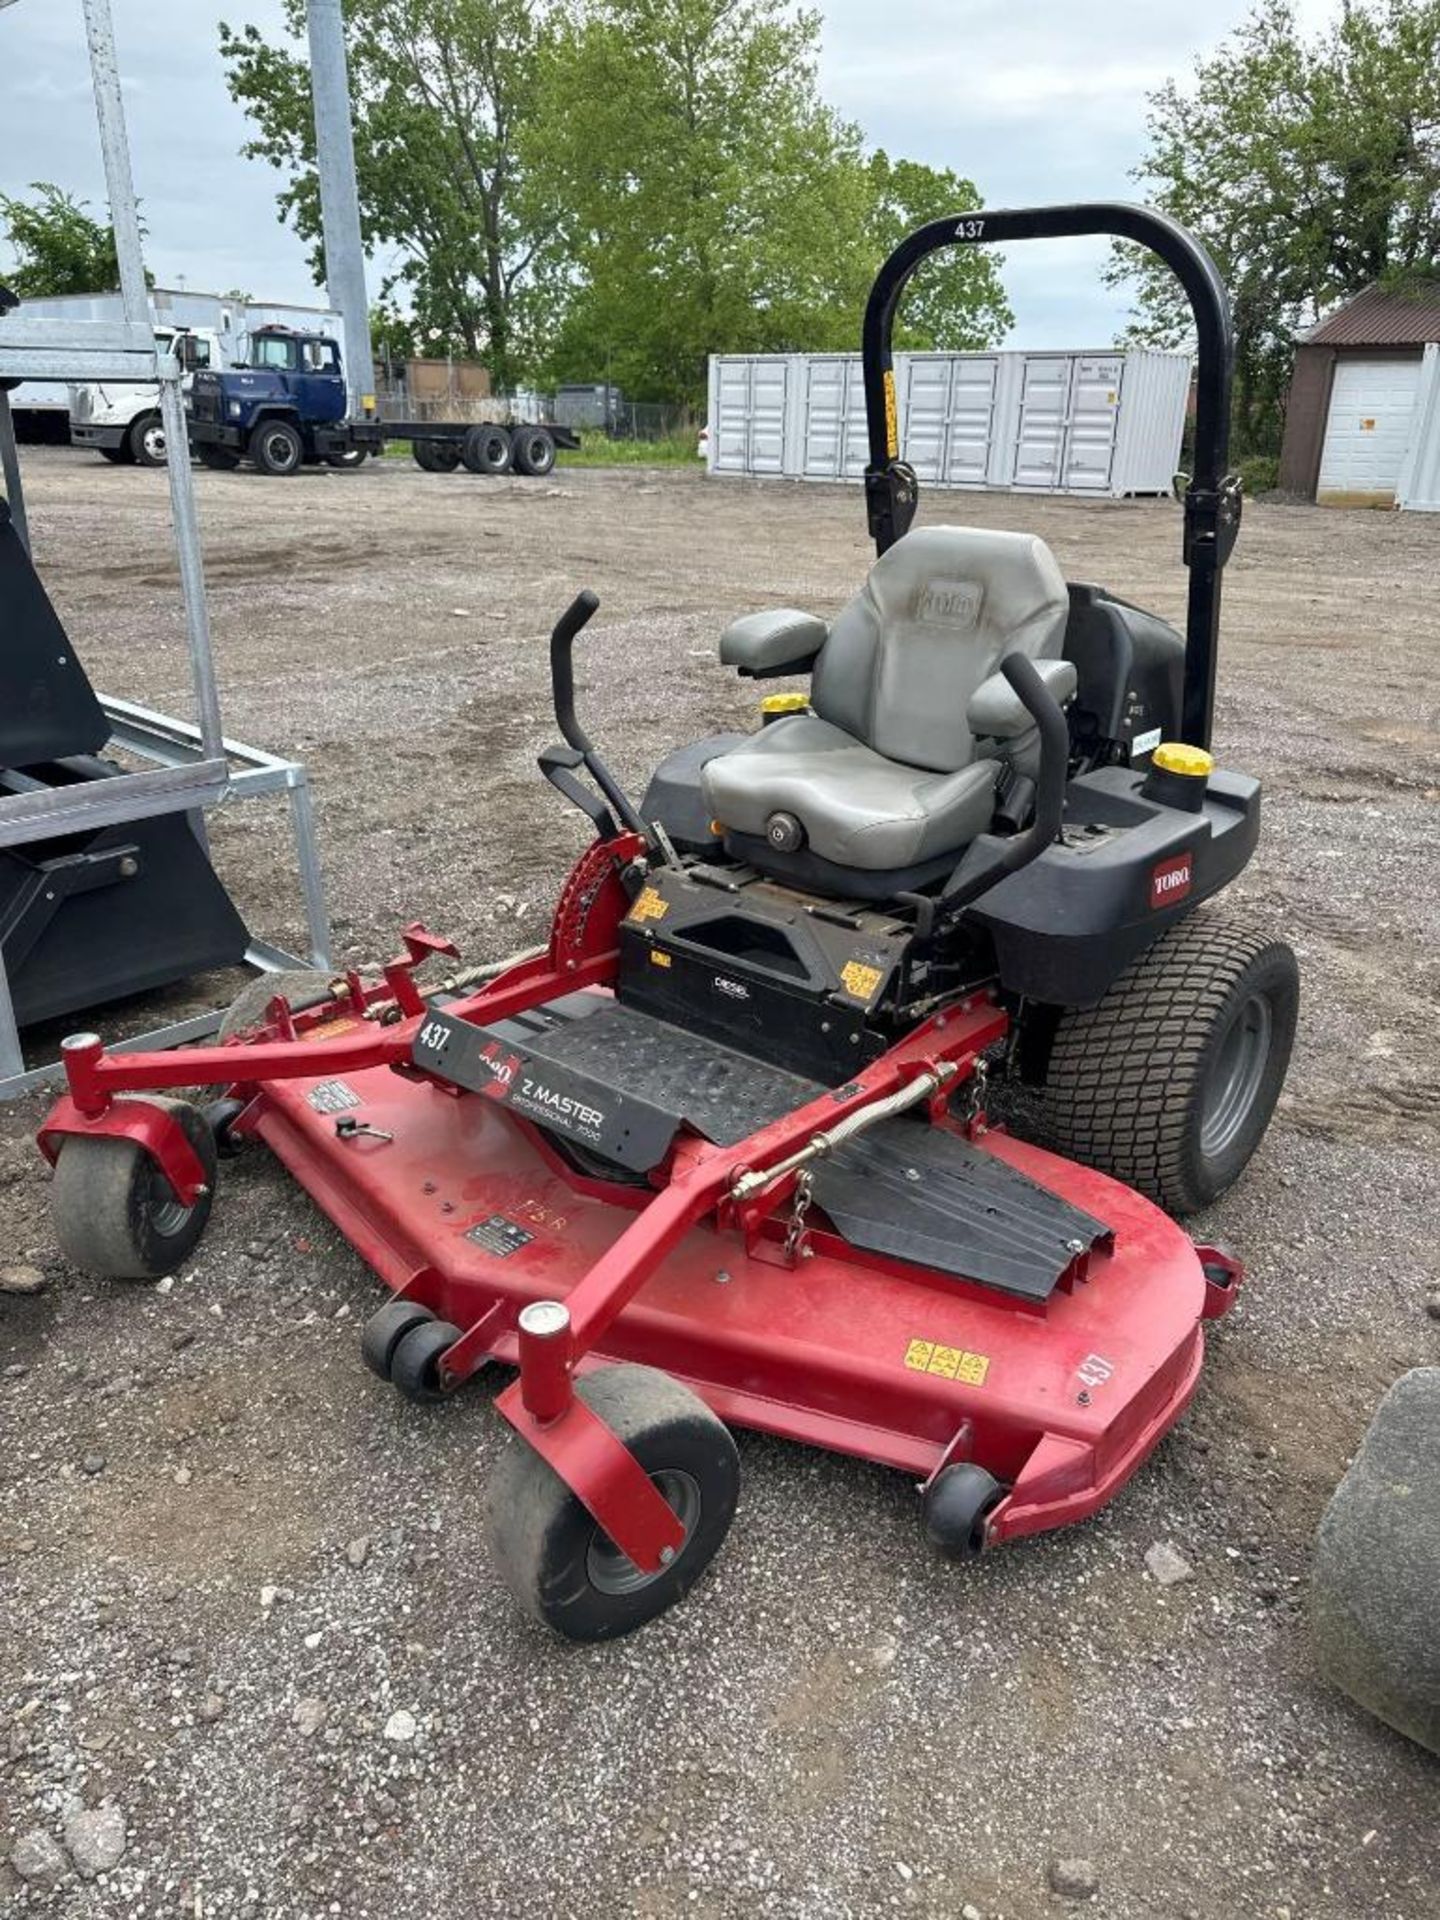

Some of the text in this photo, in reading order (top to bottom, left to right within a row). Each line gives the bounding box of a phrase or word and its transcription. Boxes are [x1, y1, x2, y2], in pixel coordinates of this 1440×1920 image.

[955, 220, 985, 239] 437
[420, 1022, 452, 1050] 437
[521, 1078, 605, 1129] Z MASTER
[1075, 1353, 1114, 1387] 437
